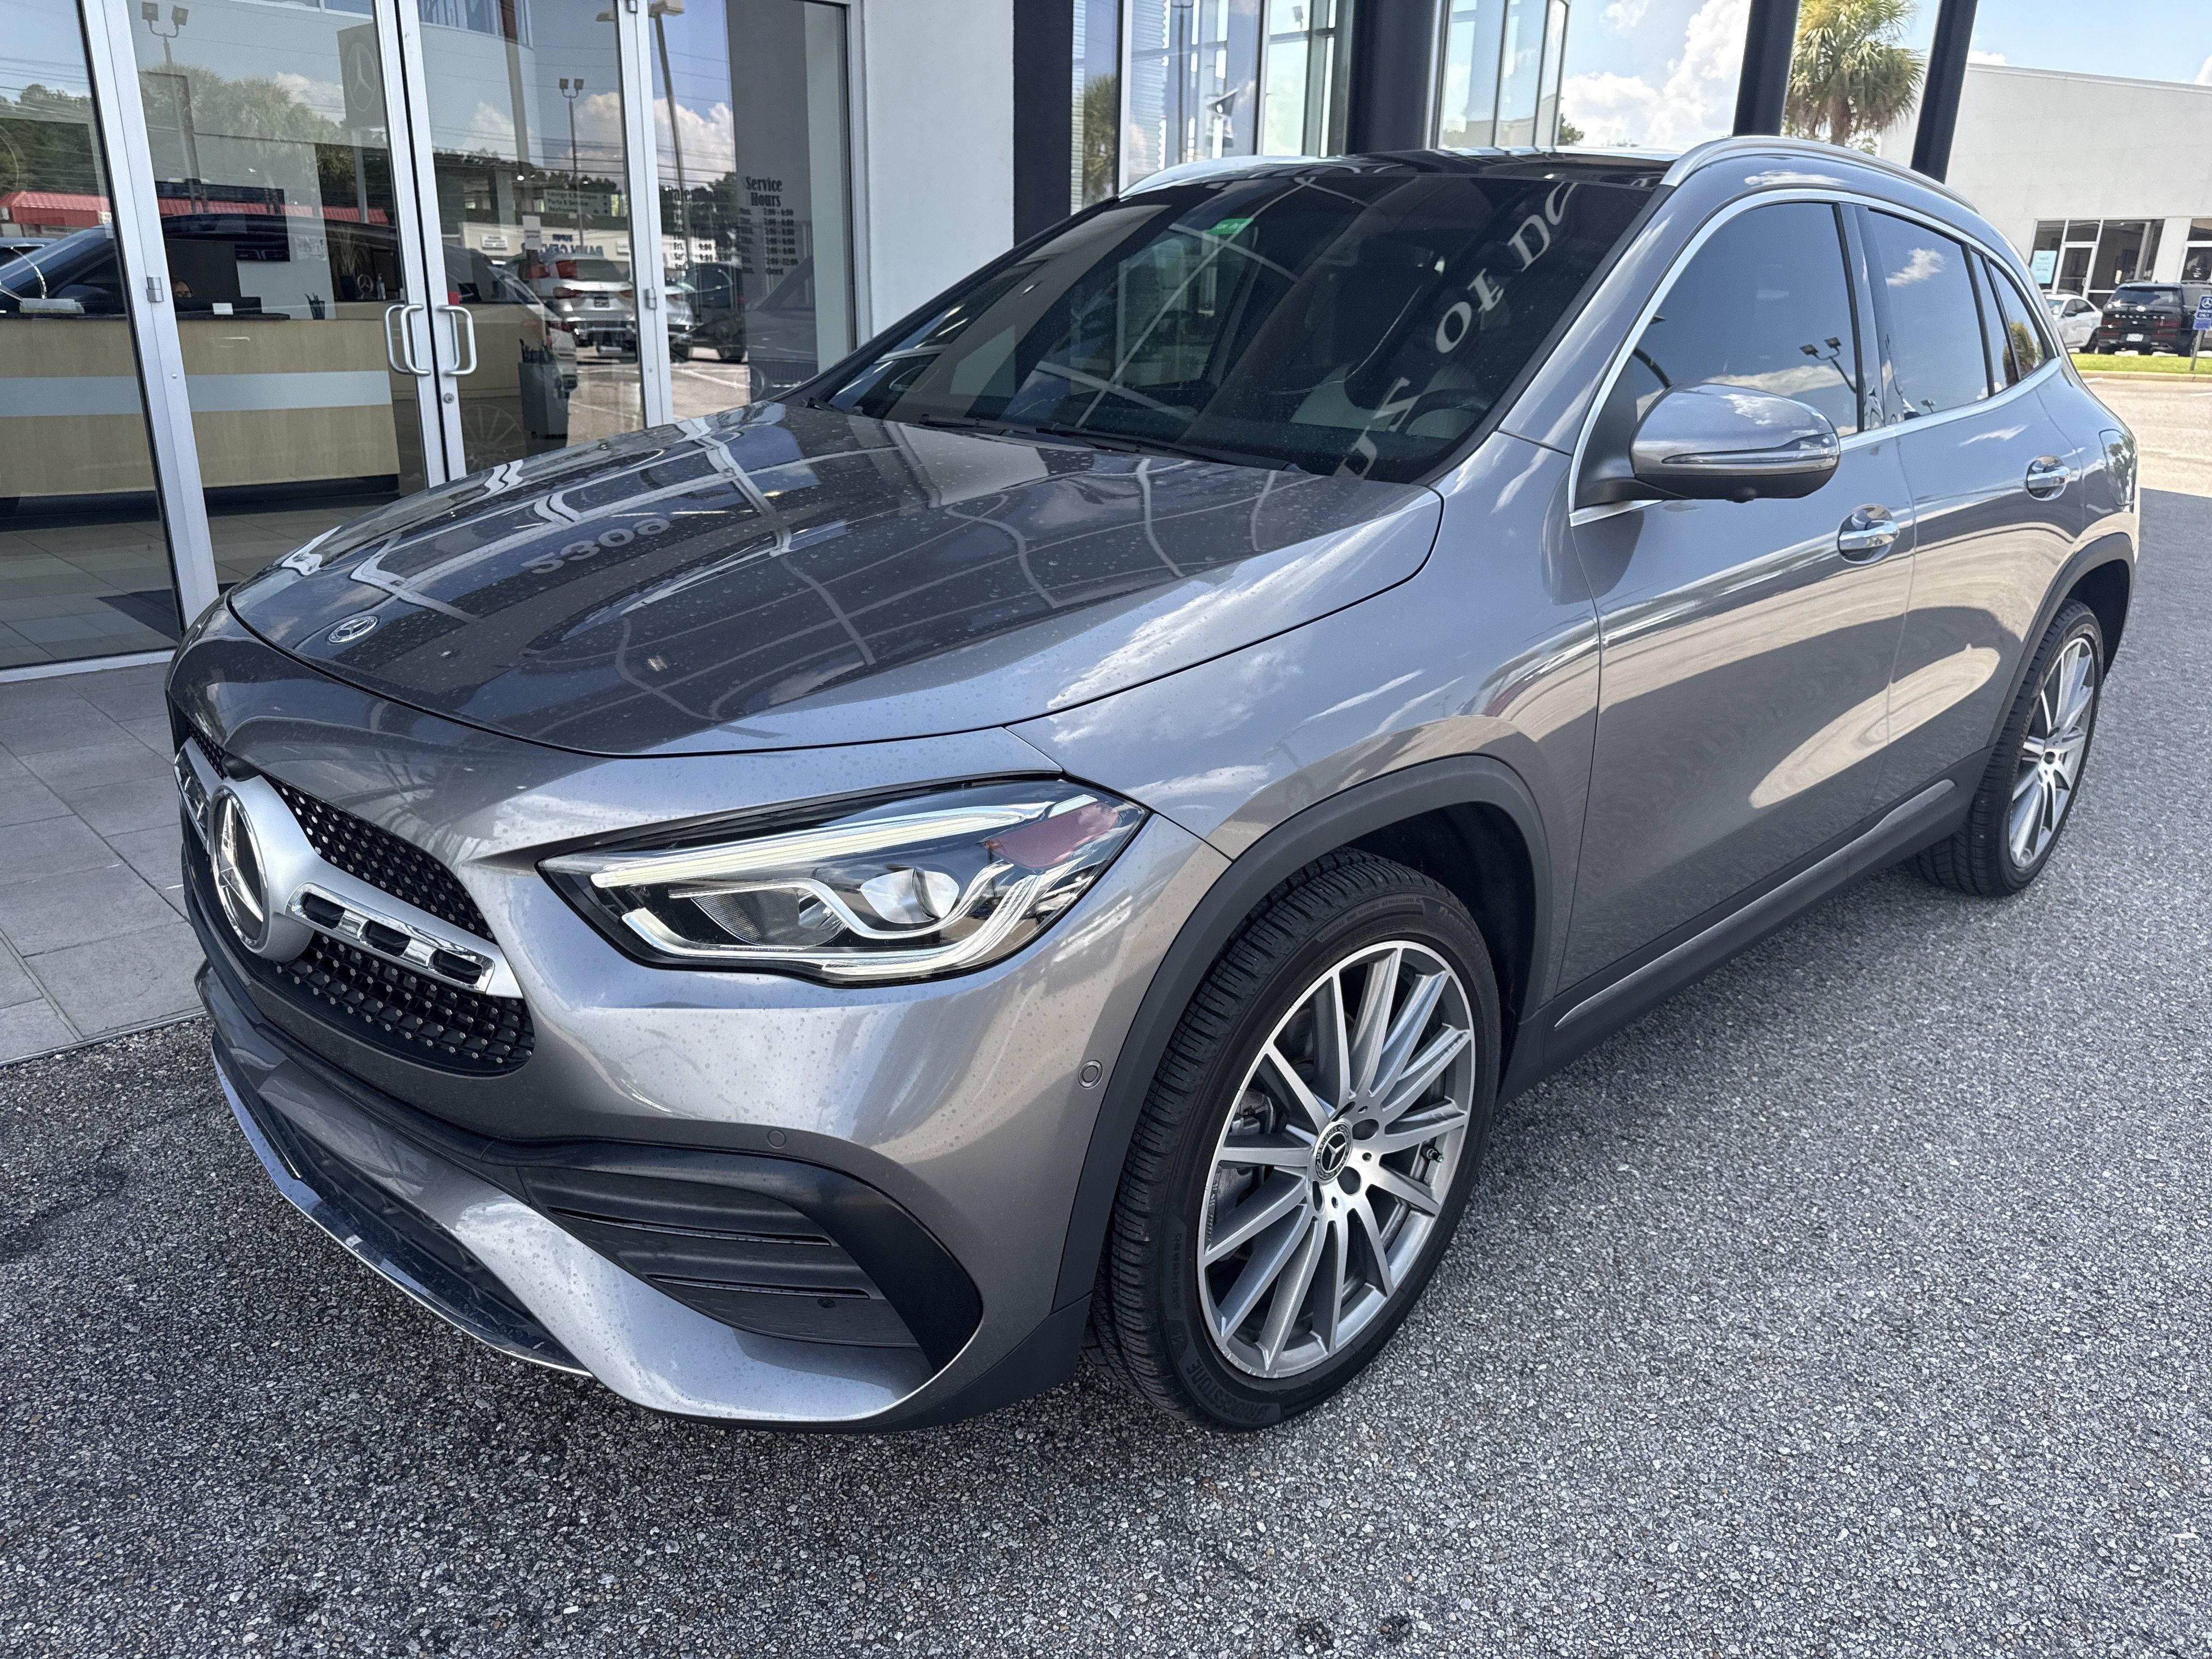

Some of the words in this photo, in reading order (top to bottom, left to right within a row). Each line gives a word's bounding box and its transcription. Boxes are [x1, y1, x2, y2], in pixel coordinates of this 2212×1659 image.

[746, 176, 783, 193] Service
[751, 192, 781, 207] Hours
[1316, 1126, 1338, 1160] MERCEDES
